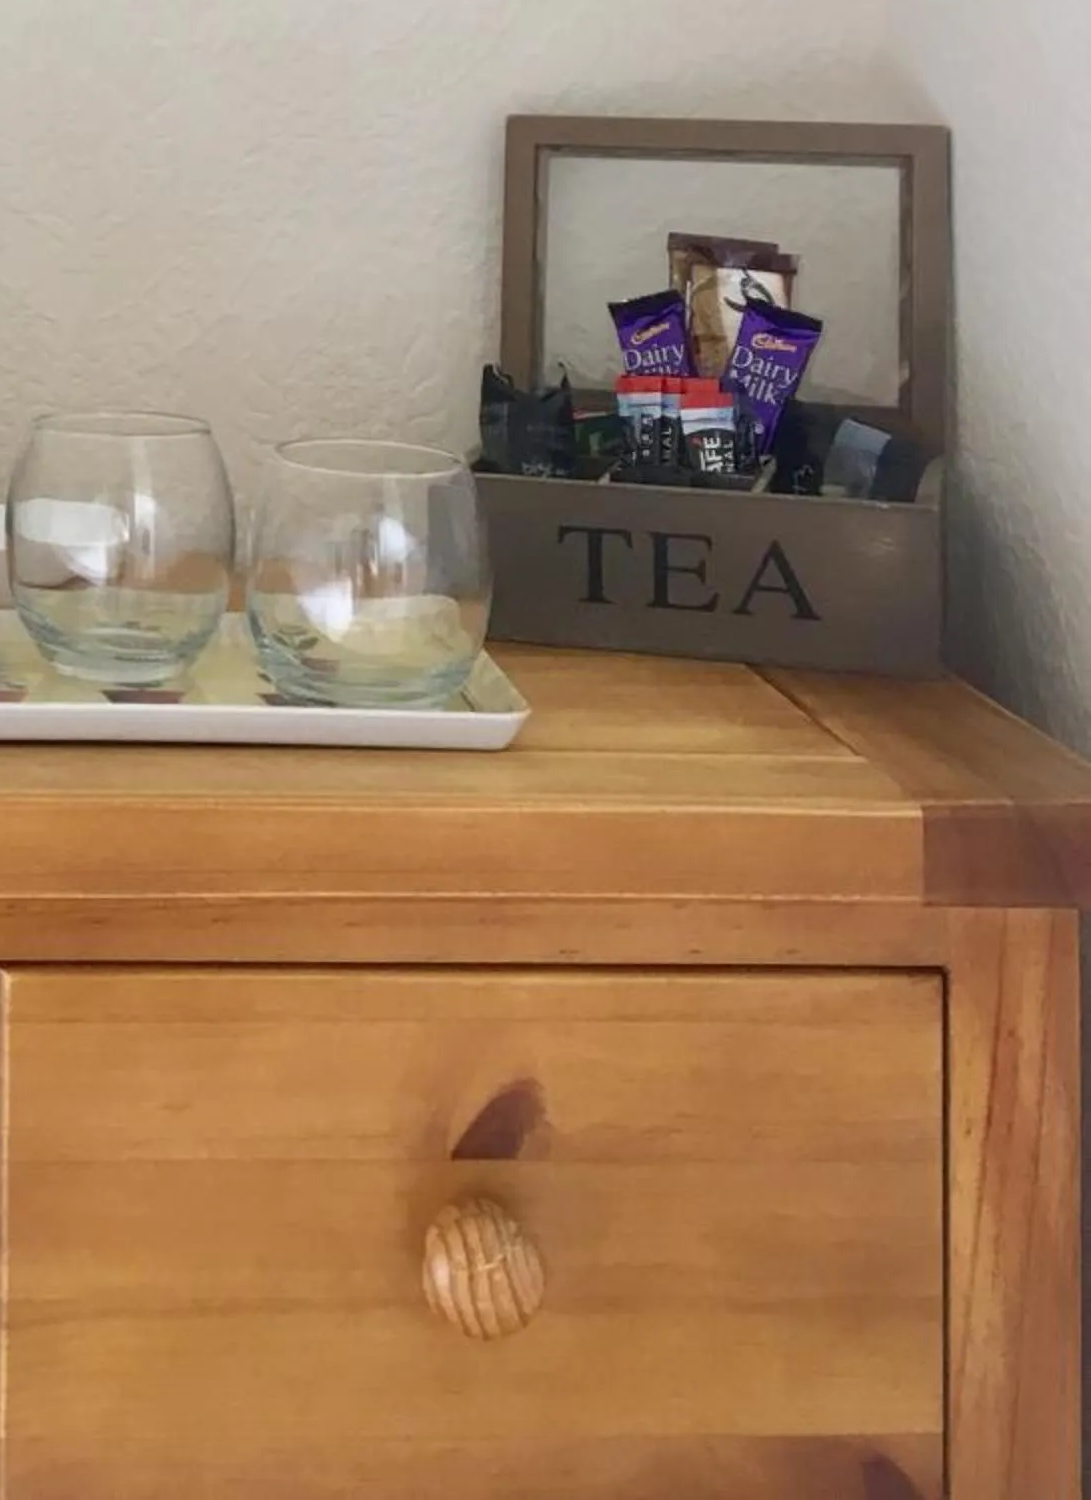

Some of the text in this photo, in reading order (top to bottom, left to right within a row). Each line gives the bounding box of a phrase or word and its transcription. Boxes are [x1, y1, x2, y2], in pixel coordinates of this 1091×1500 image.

[624, 343, 684, 371] Dairy
[732, 345, 798, 389] Dairy
[557, 525, 822, 622] TEA
